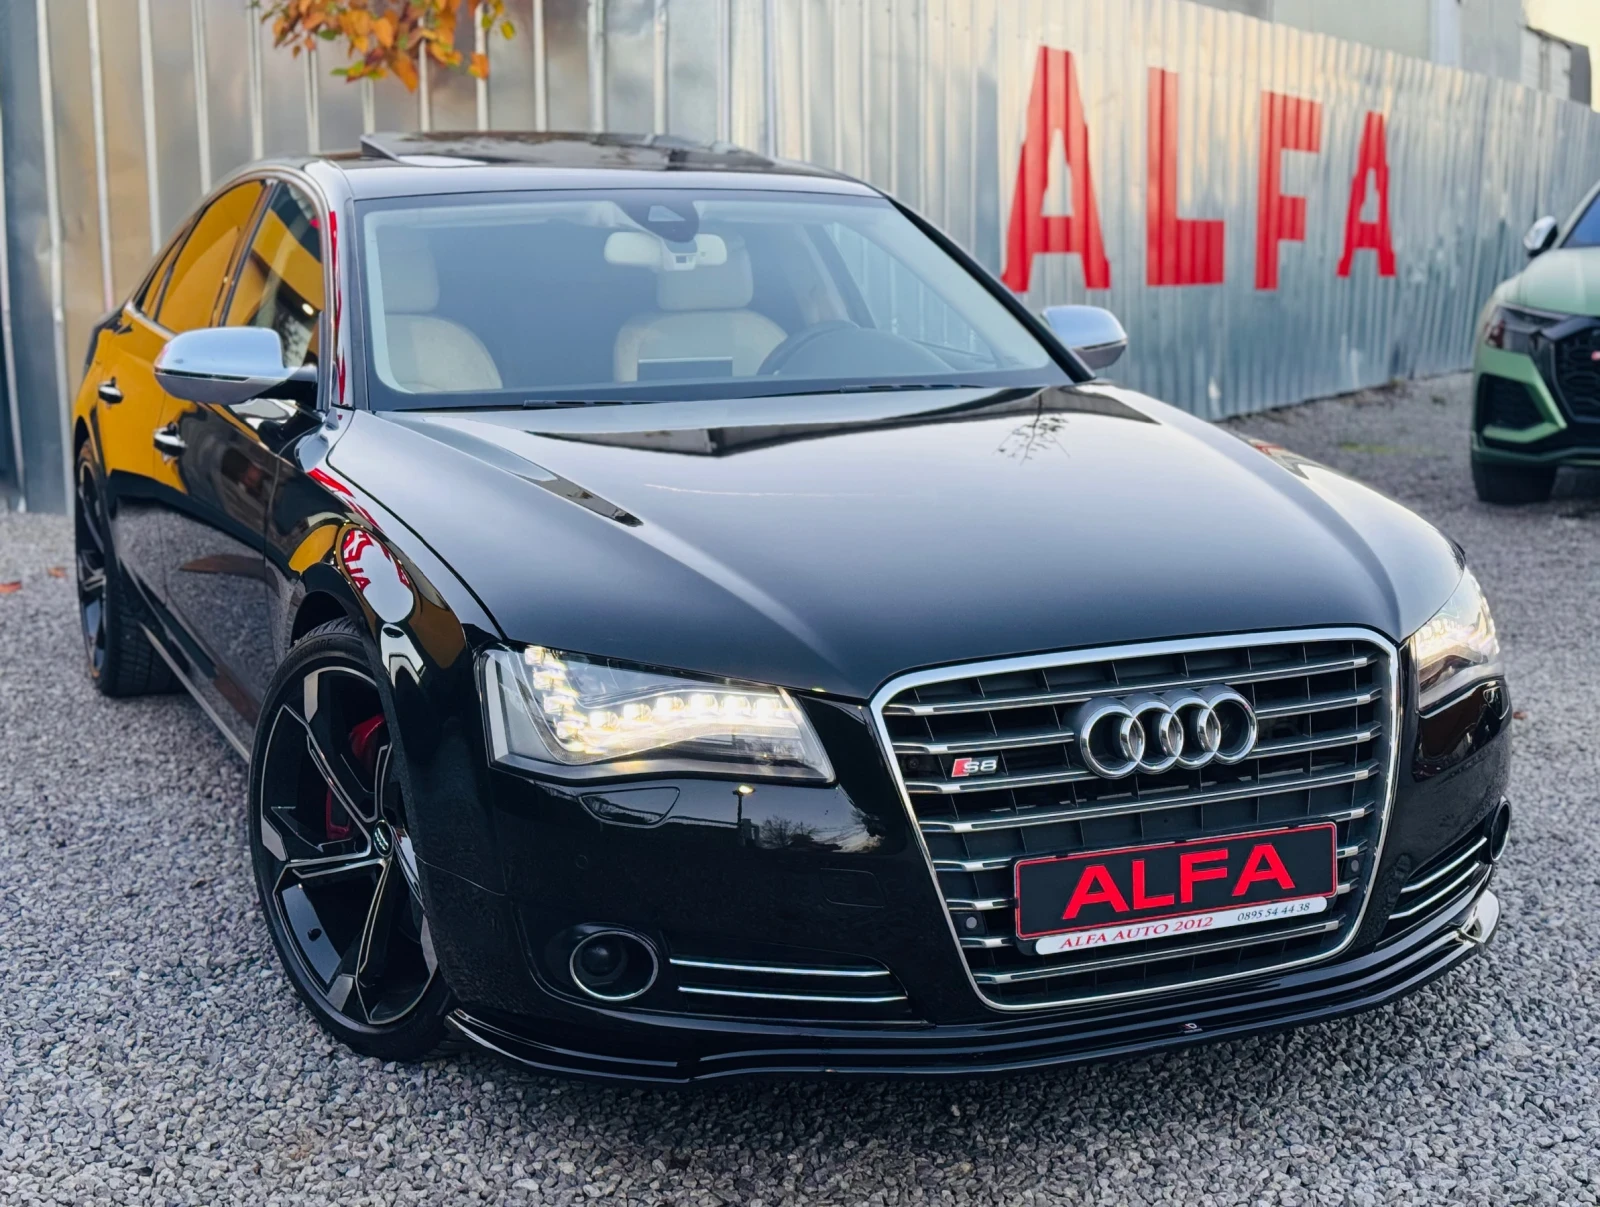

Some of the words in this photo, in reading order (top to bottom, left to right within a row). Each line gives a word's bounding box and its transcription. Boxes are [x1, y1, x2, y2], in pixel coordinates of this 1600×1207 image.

[1000, 45, 1396, 293] ALFA
[963, 760, 997, 773] S8
[1062, 843, 1296, 920] ALFA
[1059, 932, 1108, 949] ALFA
[1112, 923, 1169, 941] AUTO
[1173, 916, 1214, 932] 2012
[1237, 910, 1263, 922] 0895
[1265, 907, 1279, 918] 54
[1281, 904, 1295, 915] 44
[1297, 902, 1311, 913] 38
